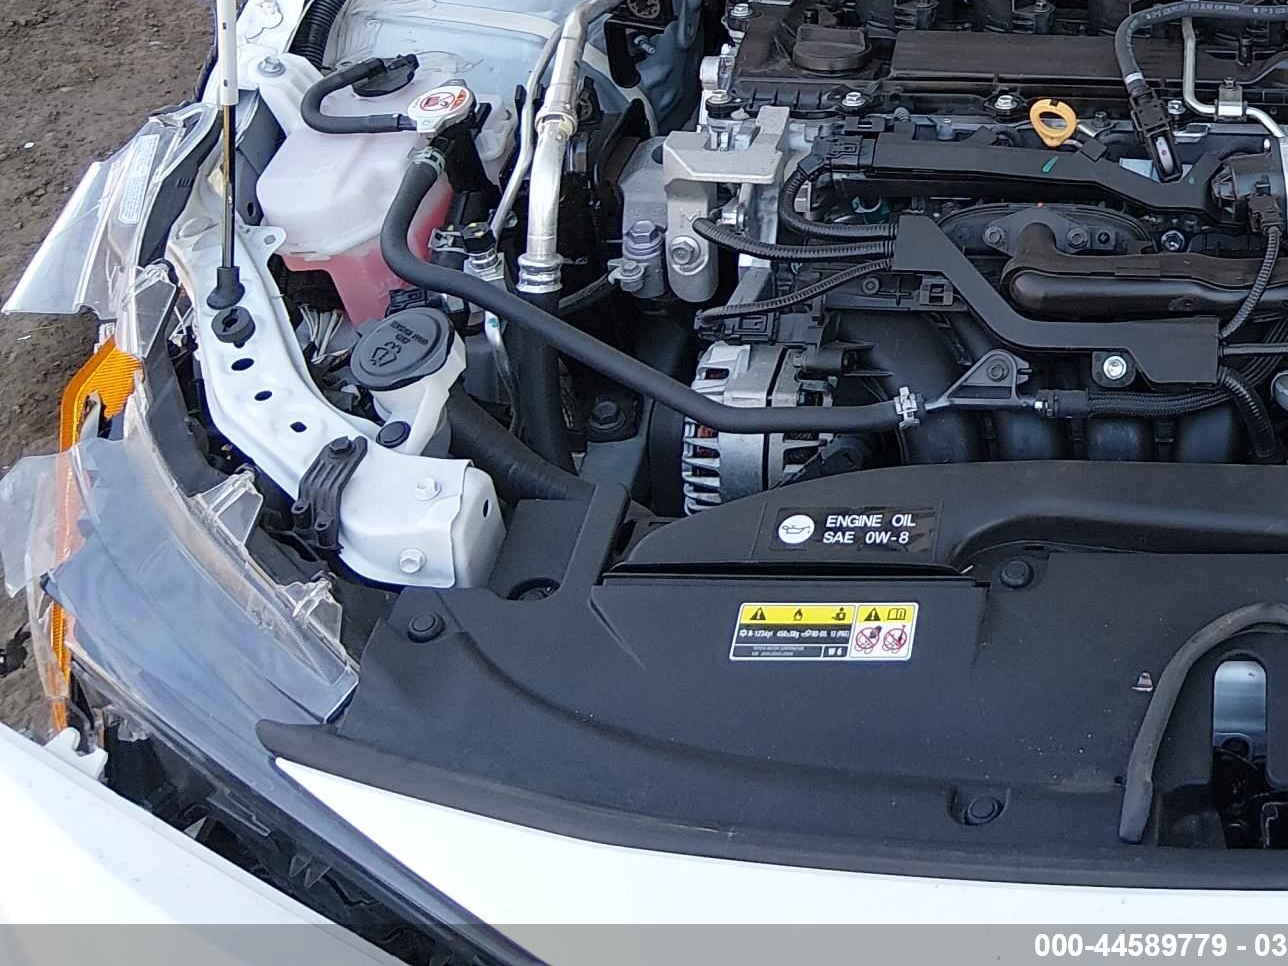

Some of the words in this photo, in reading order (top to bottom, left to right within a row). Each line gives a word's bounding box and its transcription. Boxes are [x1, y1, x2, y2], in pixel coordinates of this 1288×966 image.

[825, 514, 883, 528] ENGINE
[891, 514, 916, 527] OIL
[822, 530, 855, 544] SAE
[865, 530, 909, 544] 0W-8
